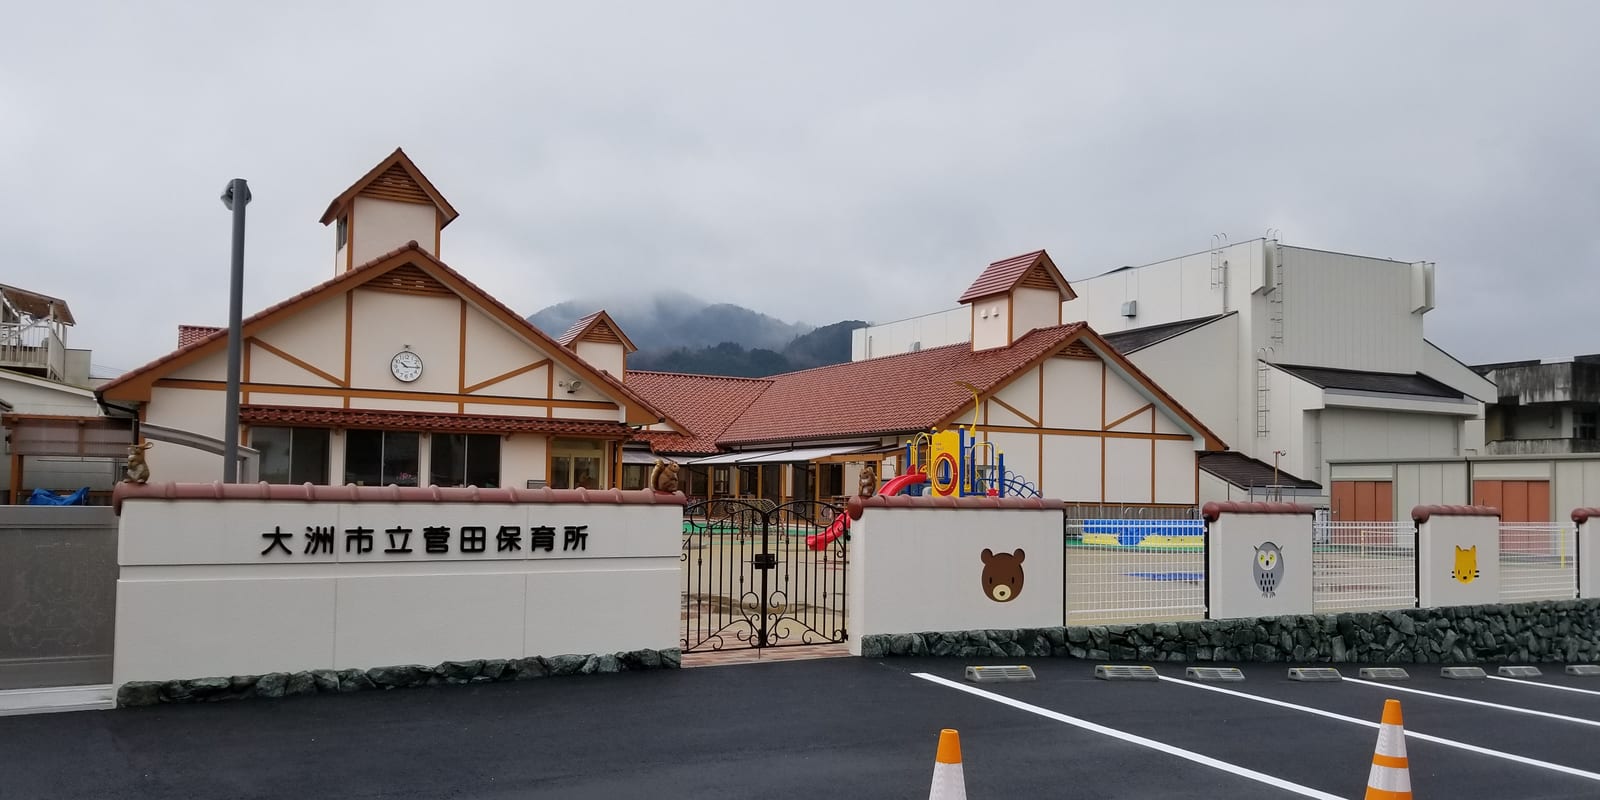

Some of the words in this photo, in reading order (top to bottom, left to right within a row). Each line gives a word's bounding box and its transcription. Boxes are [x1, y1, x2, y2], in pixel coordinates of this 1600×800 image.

[261, 526, 589, 555] 大洲市立菅田保育所
